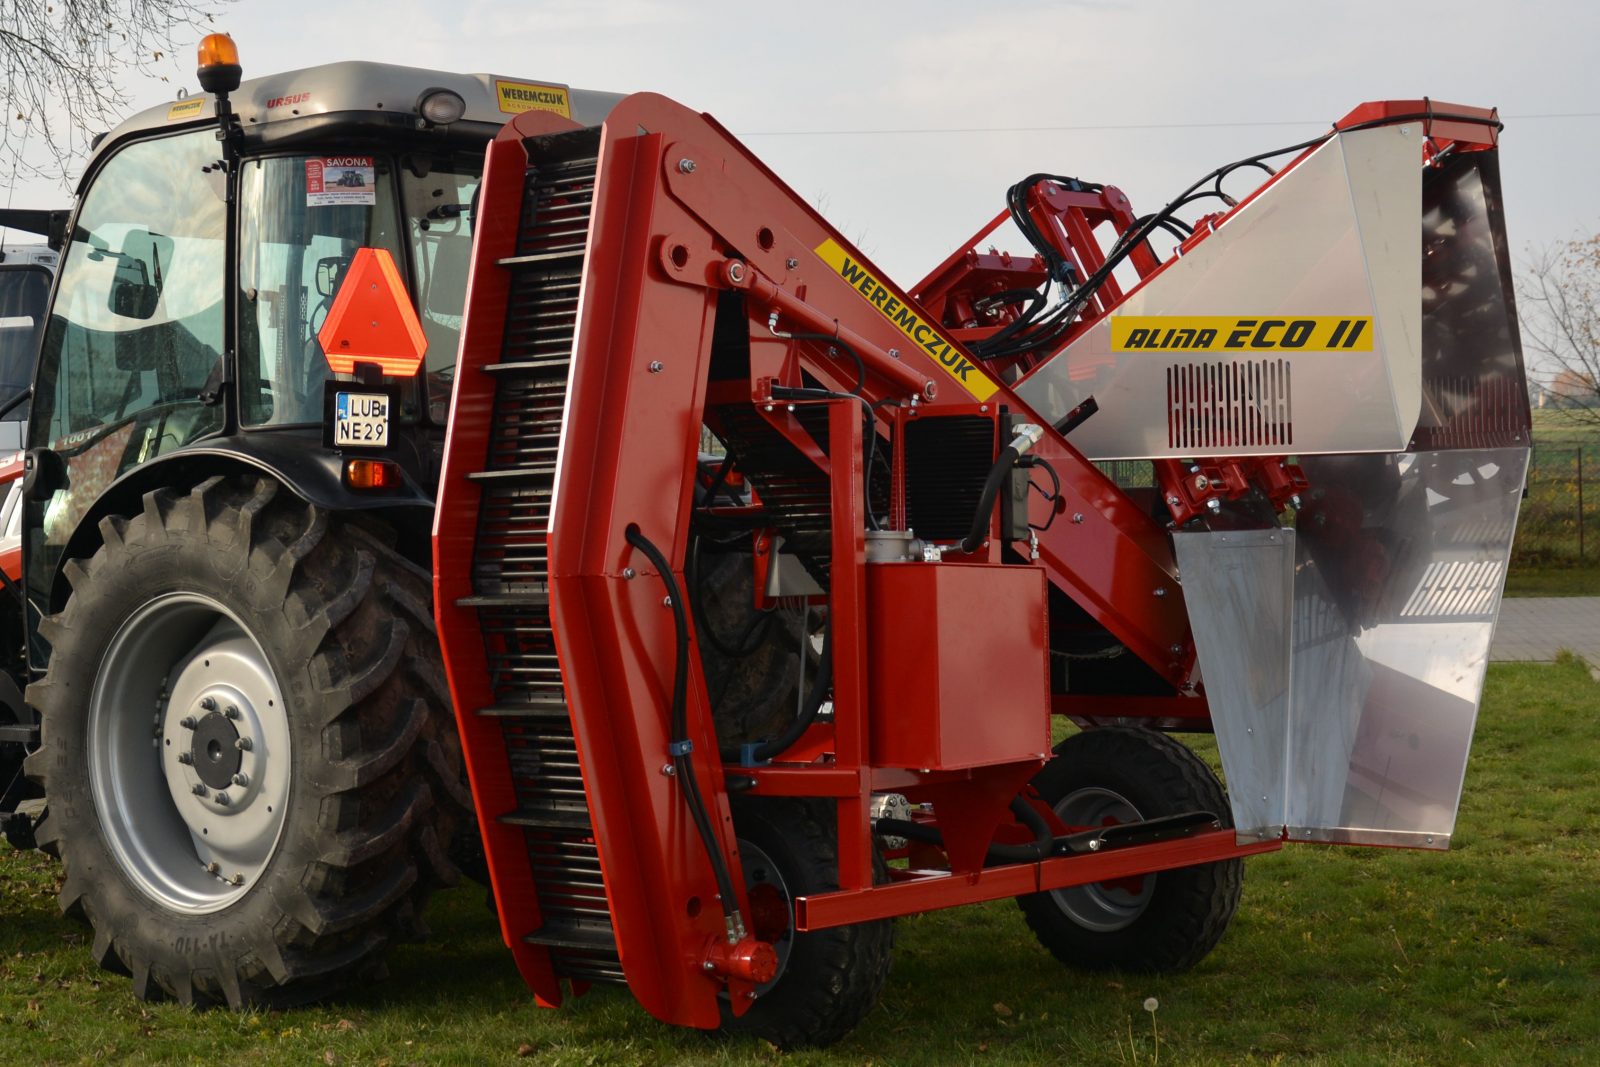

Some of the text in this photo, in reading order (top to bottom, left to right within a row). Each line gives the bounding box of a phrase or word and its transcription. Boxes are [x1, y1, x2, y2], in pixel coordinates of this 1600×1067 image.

[266, 93, 310, 109] URSUS
[501, 87, 564, 106] WEREMCZUK
[326, 158, 368, 167] SAVONA
[841, 257, 976, 382] WEREMCZUK
[1124, 329, 1217, 348] ALINA
[1224, 320, 1316, 348] ECO
[351, 399, 381, 417] LUB
[340, 422, 384, 440] NE29
